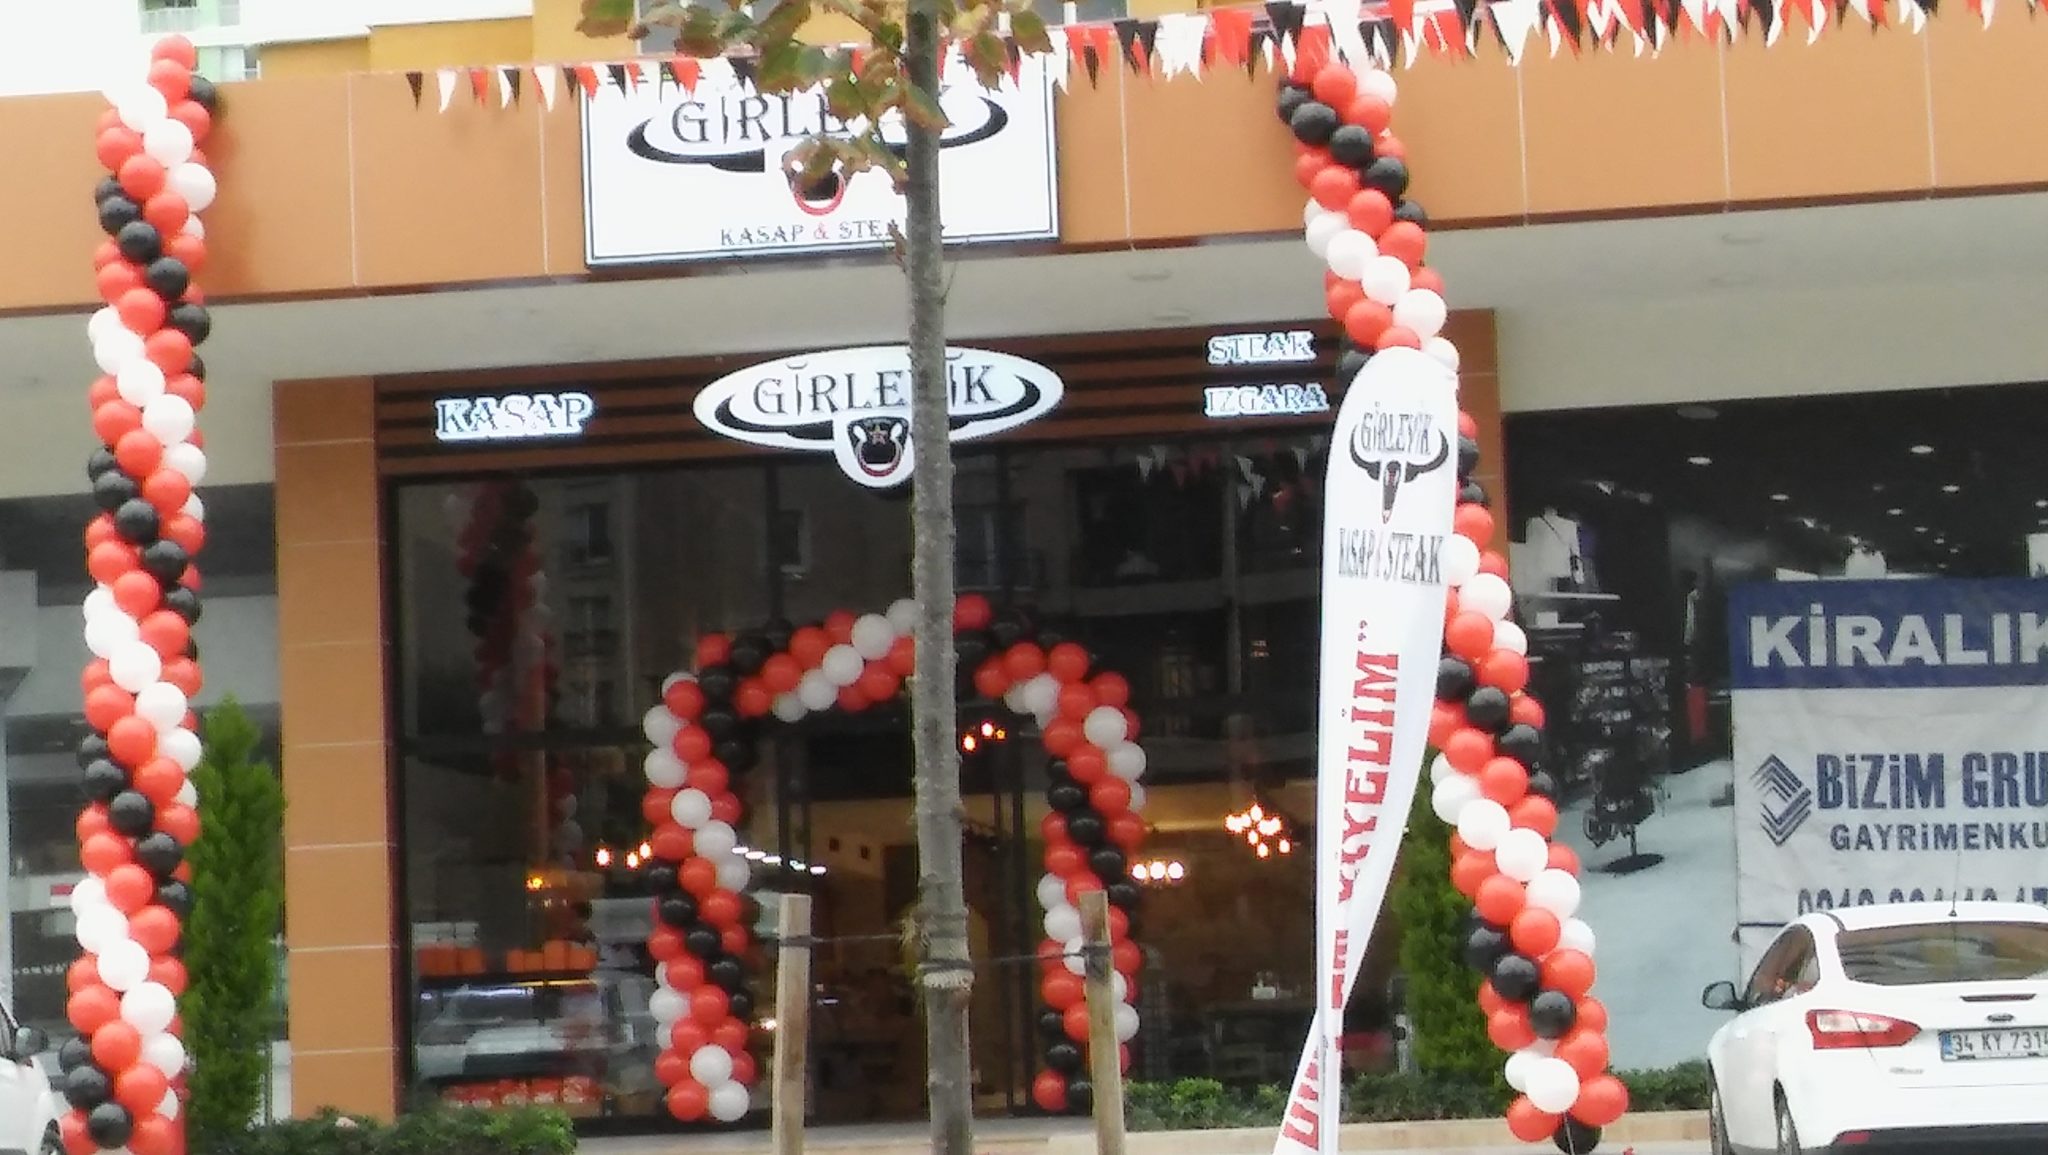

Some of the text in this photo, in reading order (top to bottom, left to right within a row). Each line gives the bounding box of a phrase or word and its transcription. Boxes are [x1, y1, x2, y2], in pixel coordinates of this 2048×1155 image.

[720, 224, 804, 247] KASAP
[813, 221, 830, 241] &
[1208, 331, 1317, 364] STEAK
[435, 393, 593, 440] KASAP
[1204, 384, 1330, 417] IZGARA
[1383, 531, 1444, 586] STEAK
[1952, 1033, 1974, 1053] 34
[1981, 1031, 2002, 1052] KY
